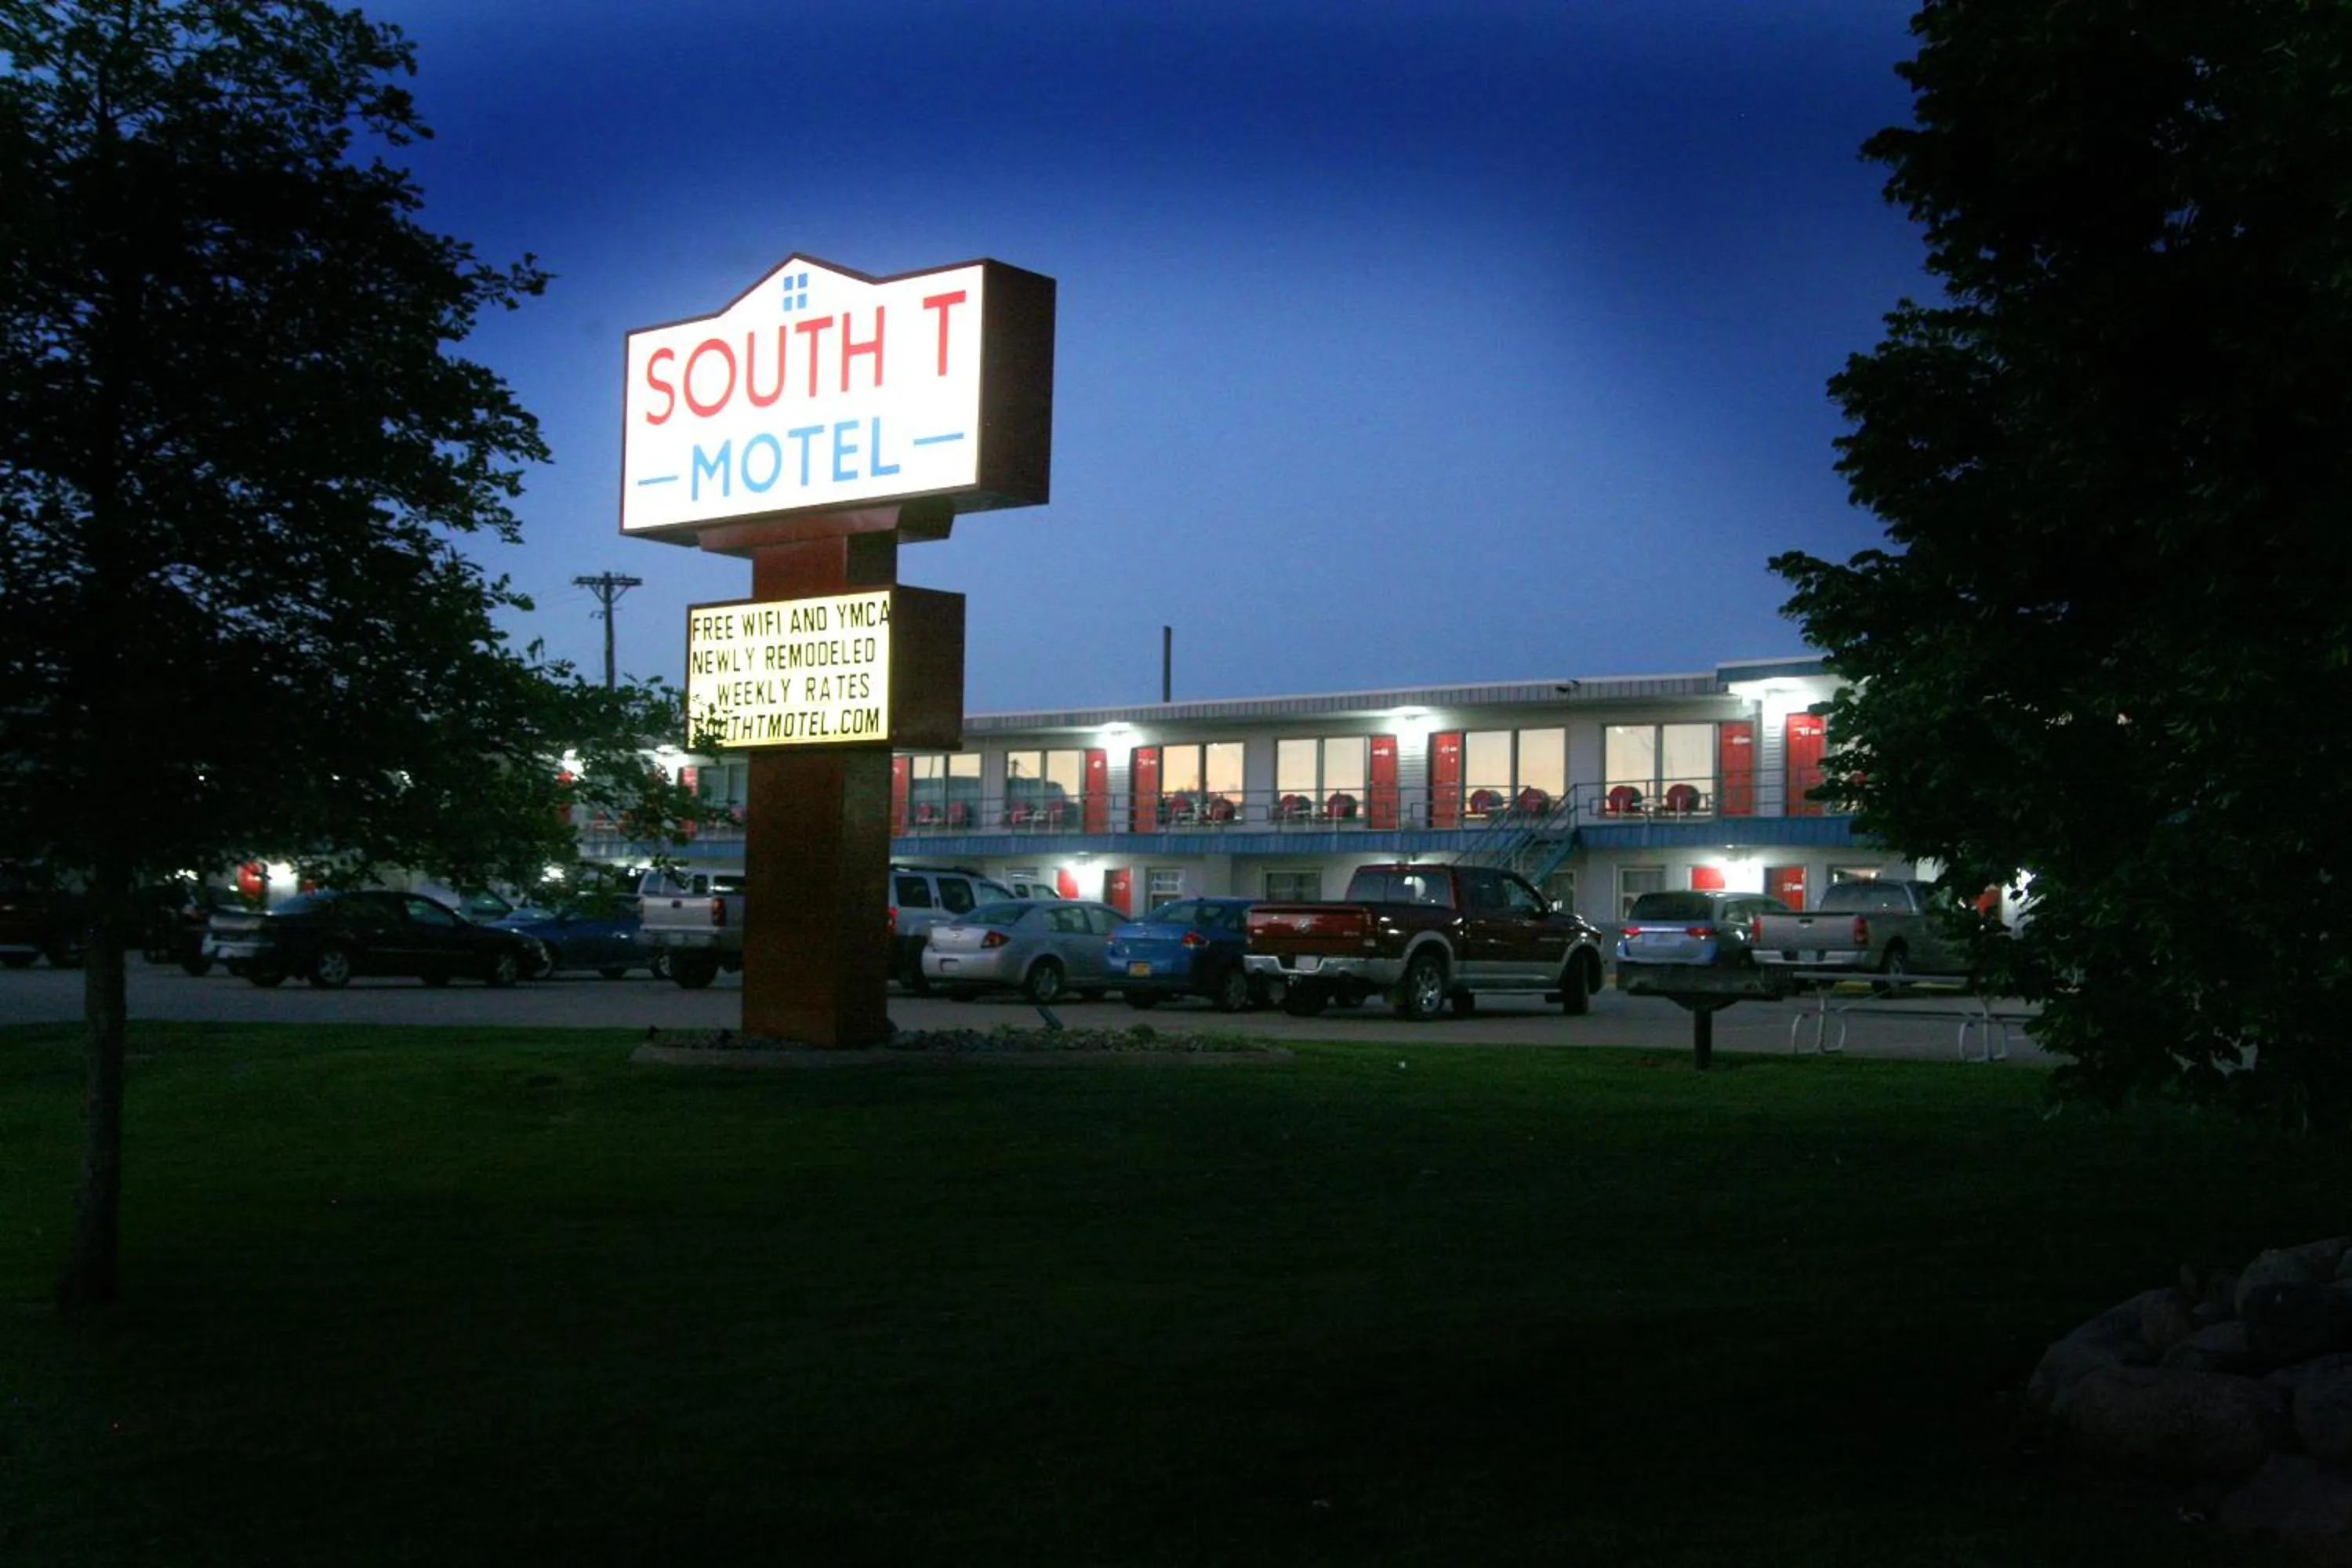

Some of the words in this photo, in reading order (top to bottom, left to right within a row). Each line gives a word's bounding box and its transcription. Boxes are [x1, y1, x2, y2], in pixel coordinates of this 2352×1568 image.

[646, 305, 885, 426] SOUTH
[923, 289, 967, 377] T
[691, 416, 901, 503] MOTEL
[692, 615, 734, 642] FREE
[741, 610, 782, 638] WIFI
[789, 606, 828, 634] AND
[836, 600, 890, 628] YMCA
[692, 646, 755, 675] NEWLY
[765, 637, 876, 670] REMODELED
[717, 678, 792, 706] WEEKLY
[804, 673, 870, 702] RATES
